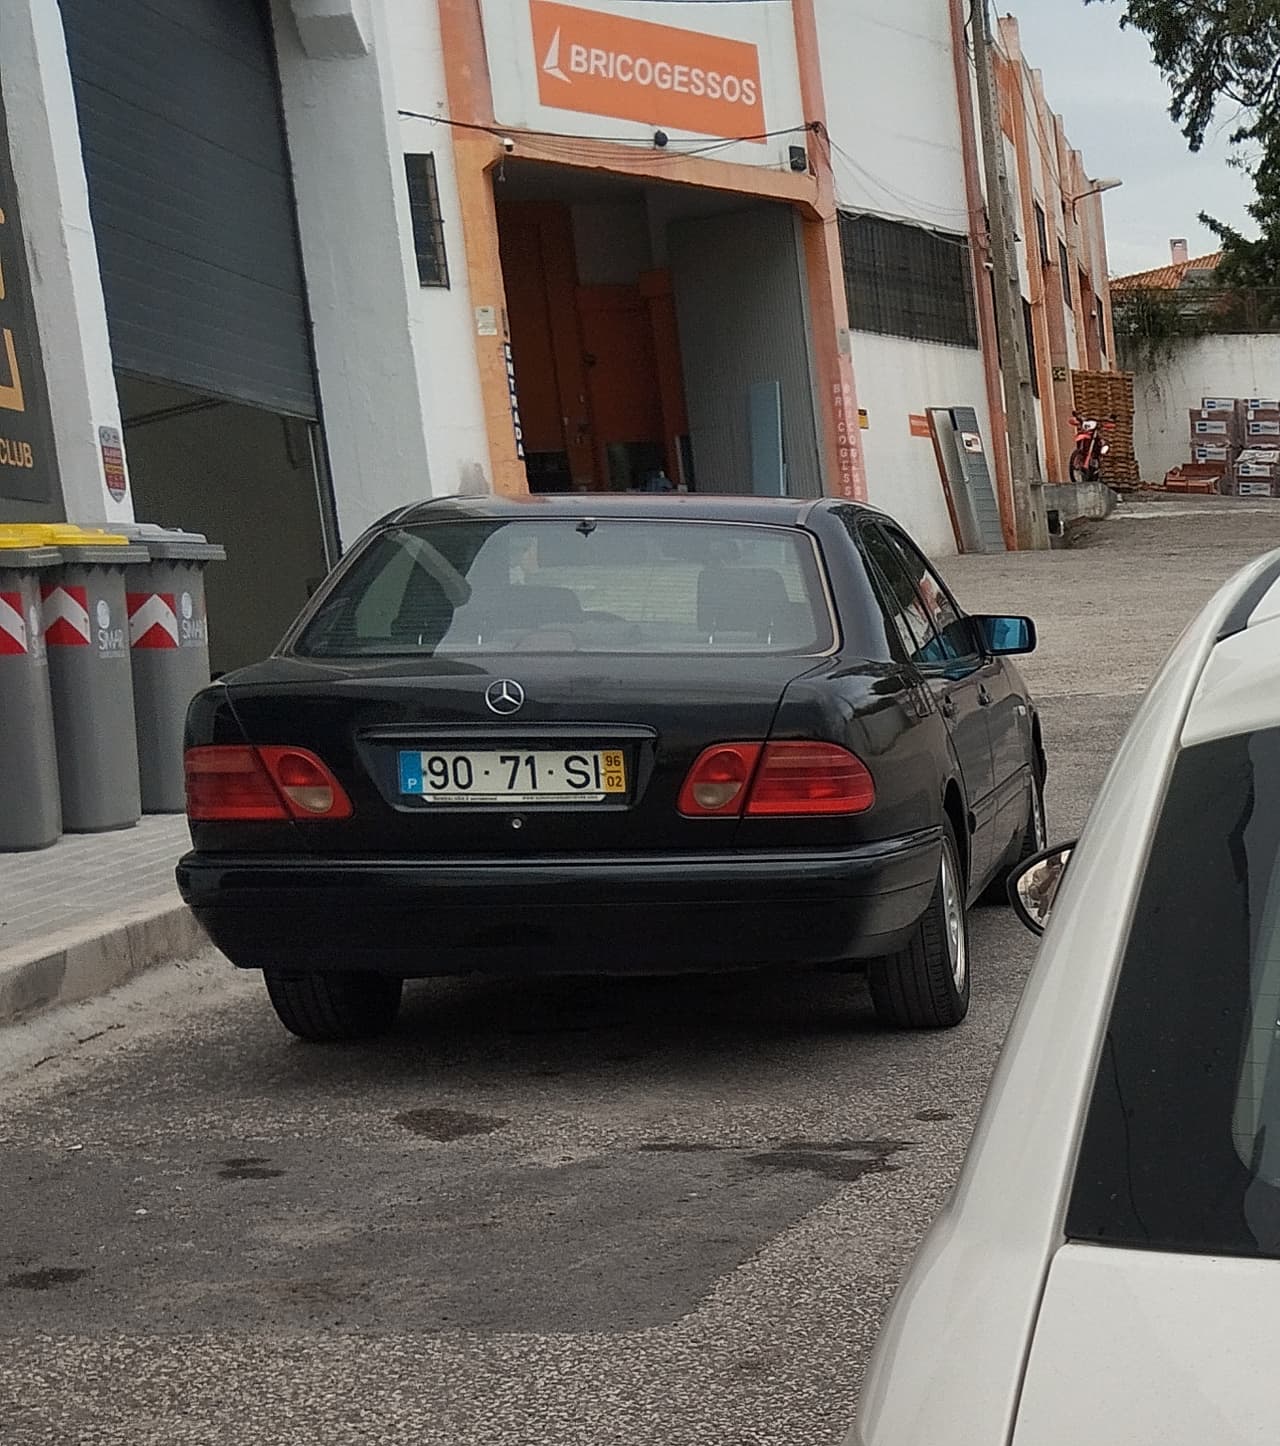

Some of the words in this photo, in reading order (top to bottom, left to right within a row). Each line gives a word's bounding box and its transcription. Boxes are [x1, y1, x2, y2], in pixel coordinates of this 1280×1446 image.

[570, 44, 757, 106] BRICOGESSOS
[0, 437, 34, 469] CLUB
[605, 755, 621, 768] 96
[408, 777, 417, 790] P
[606, 775, 623, 788] 02
